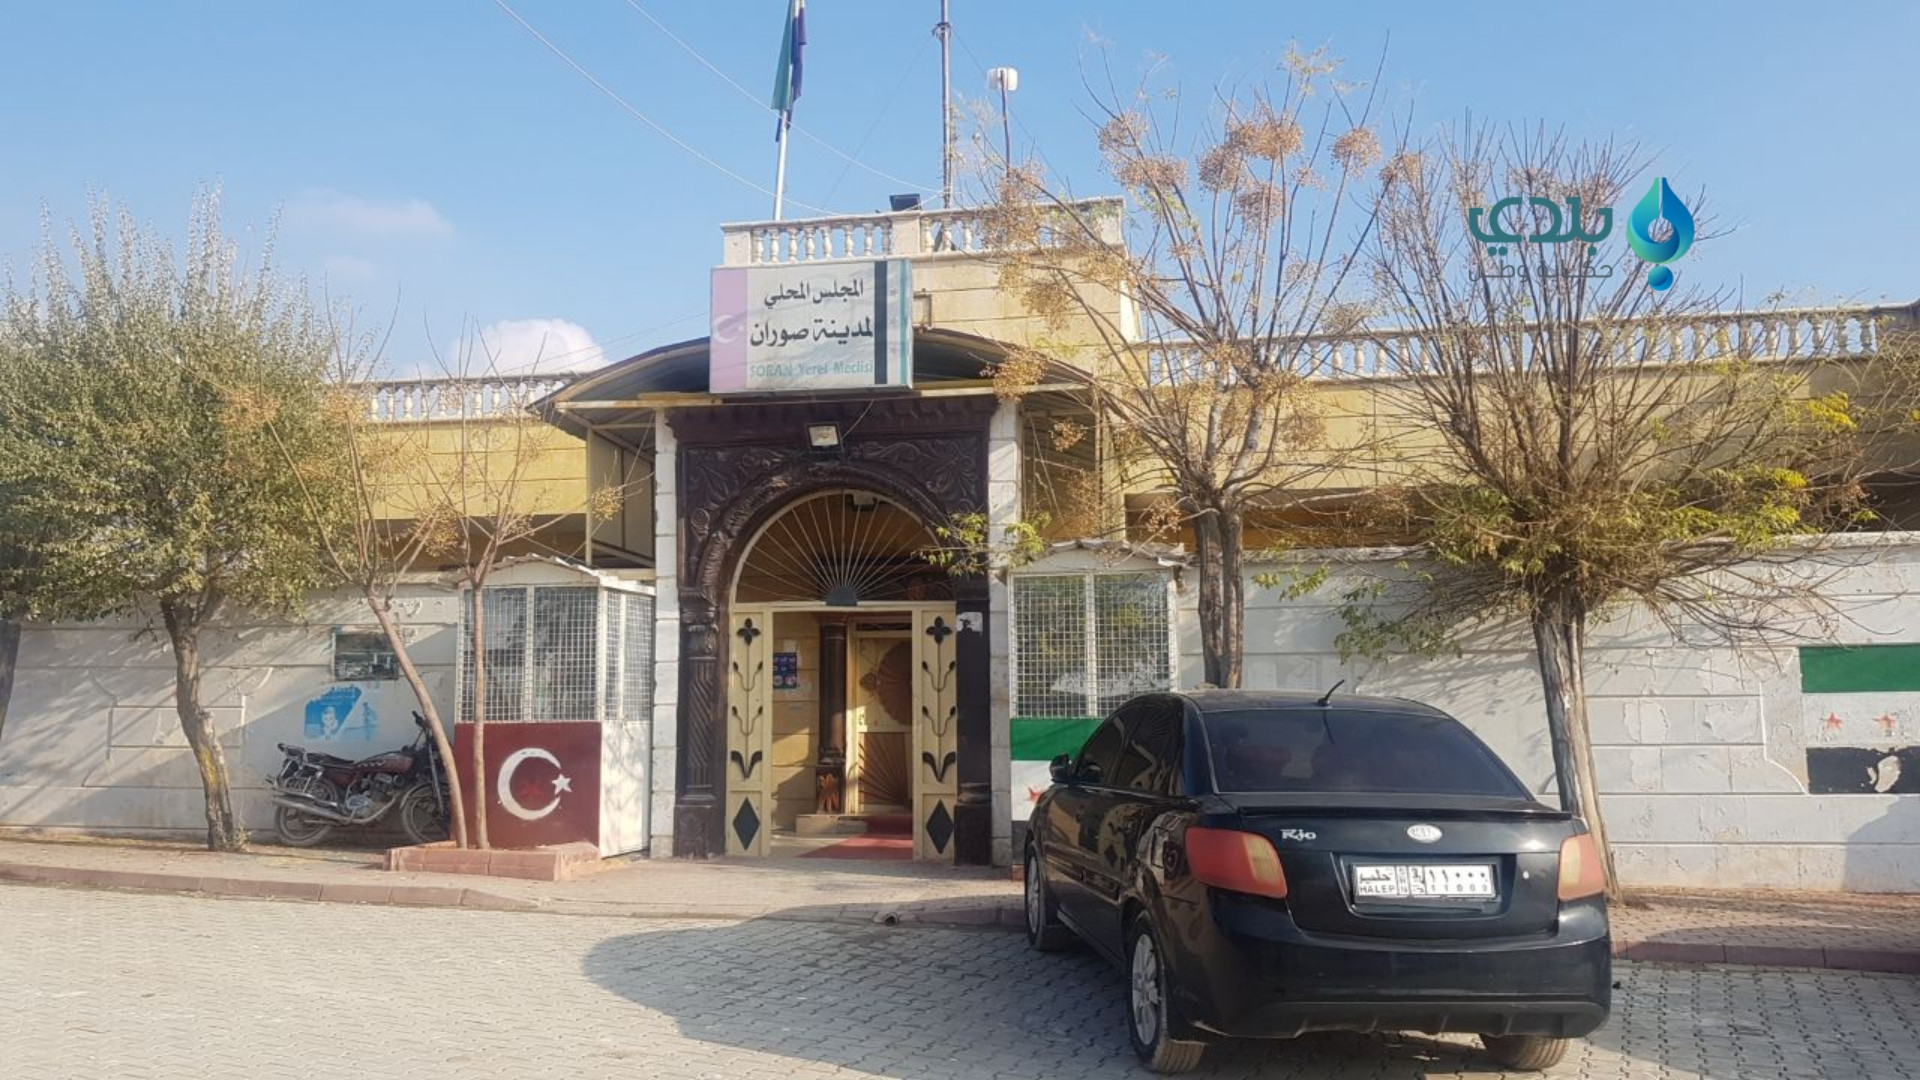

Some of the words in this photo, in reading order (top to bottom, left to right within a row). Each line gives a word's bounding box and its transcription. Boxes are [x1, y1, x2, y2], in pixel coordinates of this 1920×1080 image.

[764, 281, 810, 309] المحلي
[813, 278, 863, 304] المجلس
[750, 319, 809, 347] صوران
[812, 316, 873, 345] لمدينة
[750, 362, 793, 377] SORAN
[798, 361, 829, 375] Yerel
[833, 359, 873, 374] Meclisi
[1360, 884, 1395, 894] HALEP
